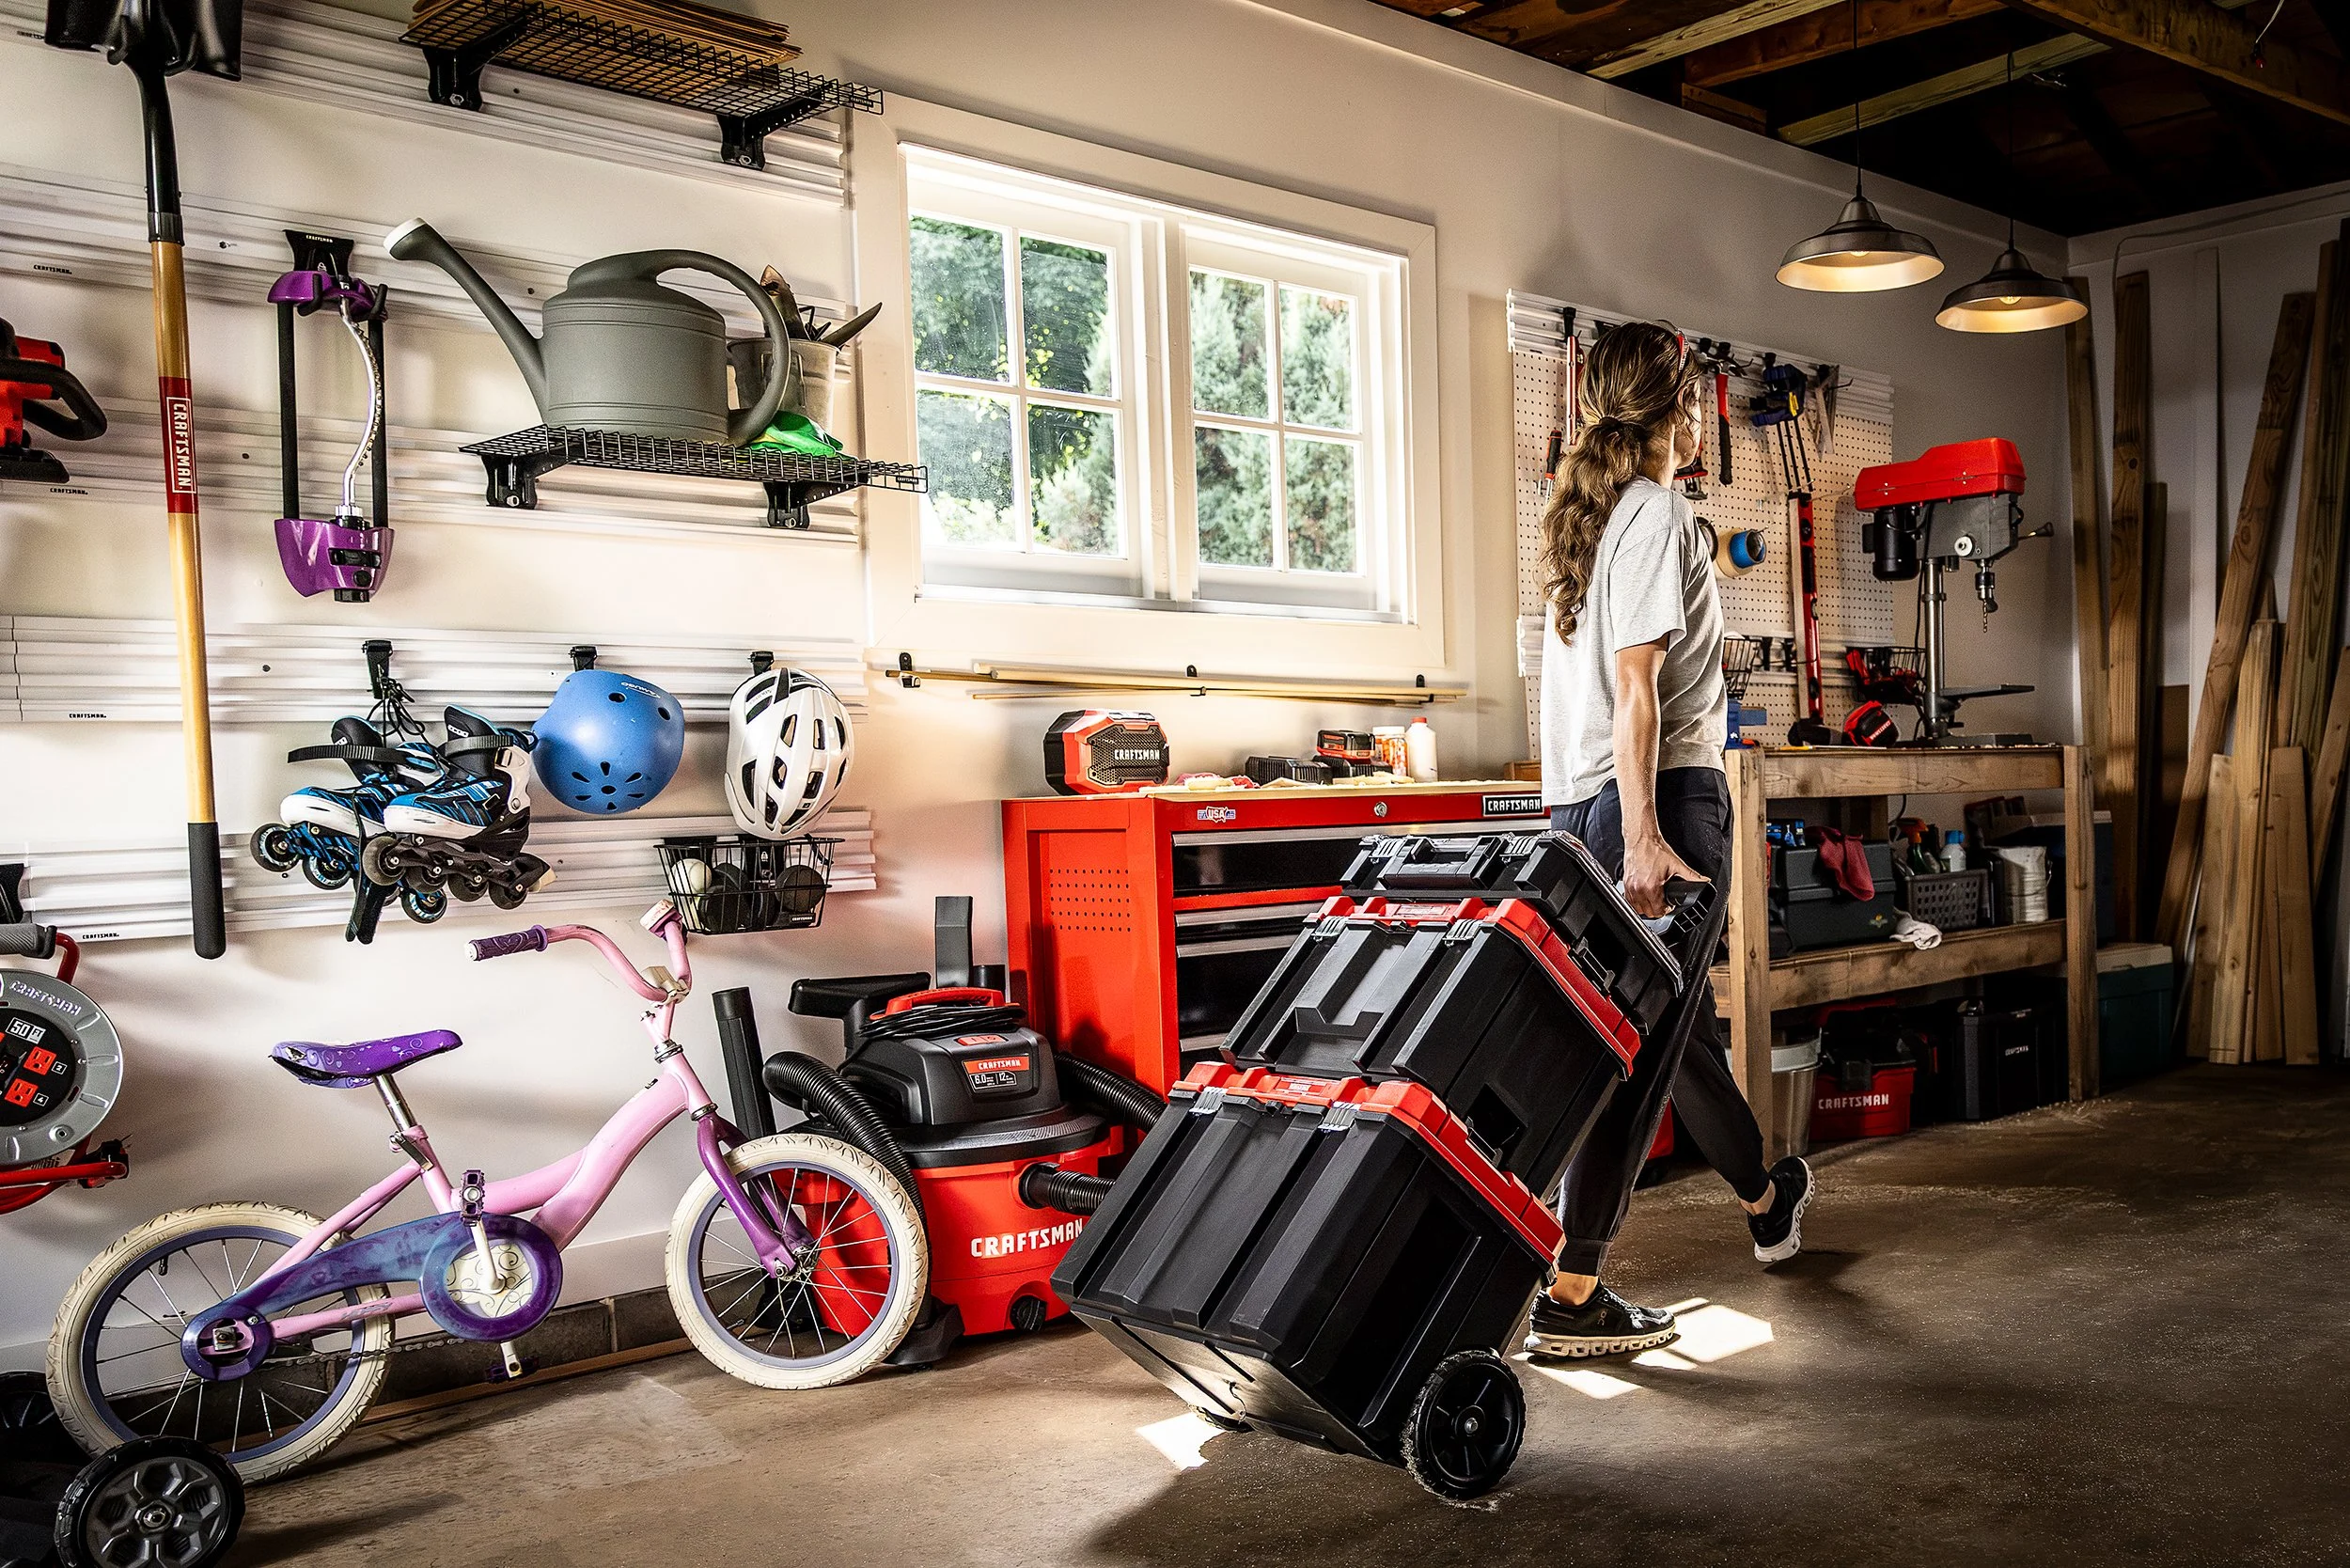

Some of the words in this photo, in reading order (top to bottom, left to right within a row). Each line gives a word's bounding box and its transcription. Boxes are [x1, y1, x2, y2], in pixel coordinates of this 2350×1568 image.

[174, 403, 192, 487] CRAFTSMAN
[1114, 749, 1160, 760] CRAFTSMAN
[1488, 799, 1541, 811] CRAFTSMAN
[1208, 809, 1225, 819] USA
[9, 980, 82, 1015] CRAFTSMAN
[10, 1020, 31, 1037] 50
[978, 1058, 1022, 1071] CRAFTSMAN
[974, 1074, 987, 1085] 6.0
[998, 1073, 1007, 1081] 12
[1818, 1094, 1889, 1109] CRAFTSMAN
[971, 1218, 1083, 1258] CRAFTSMAN
